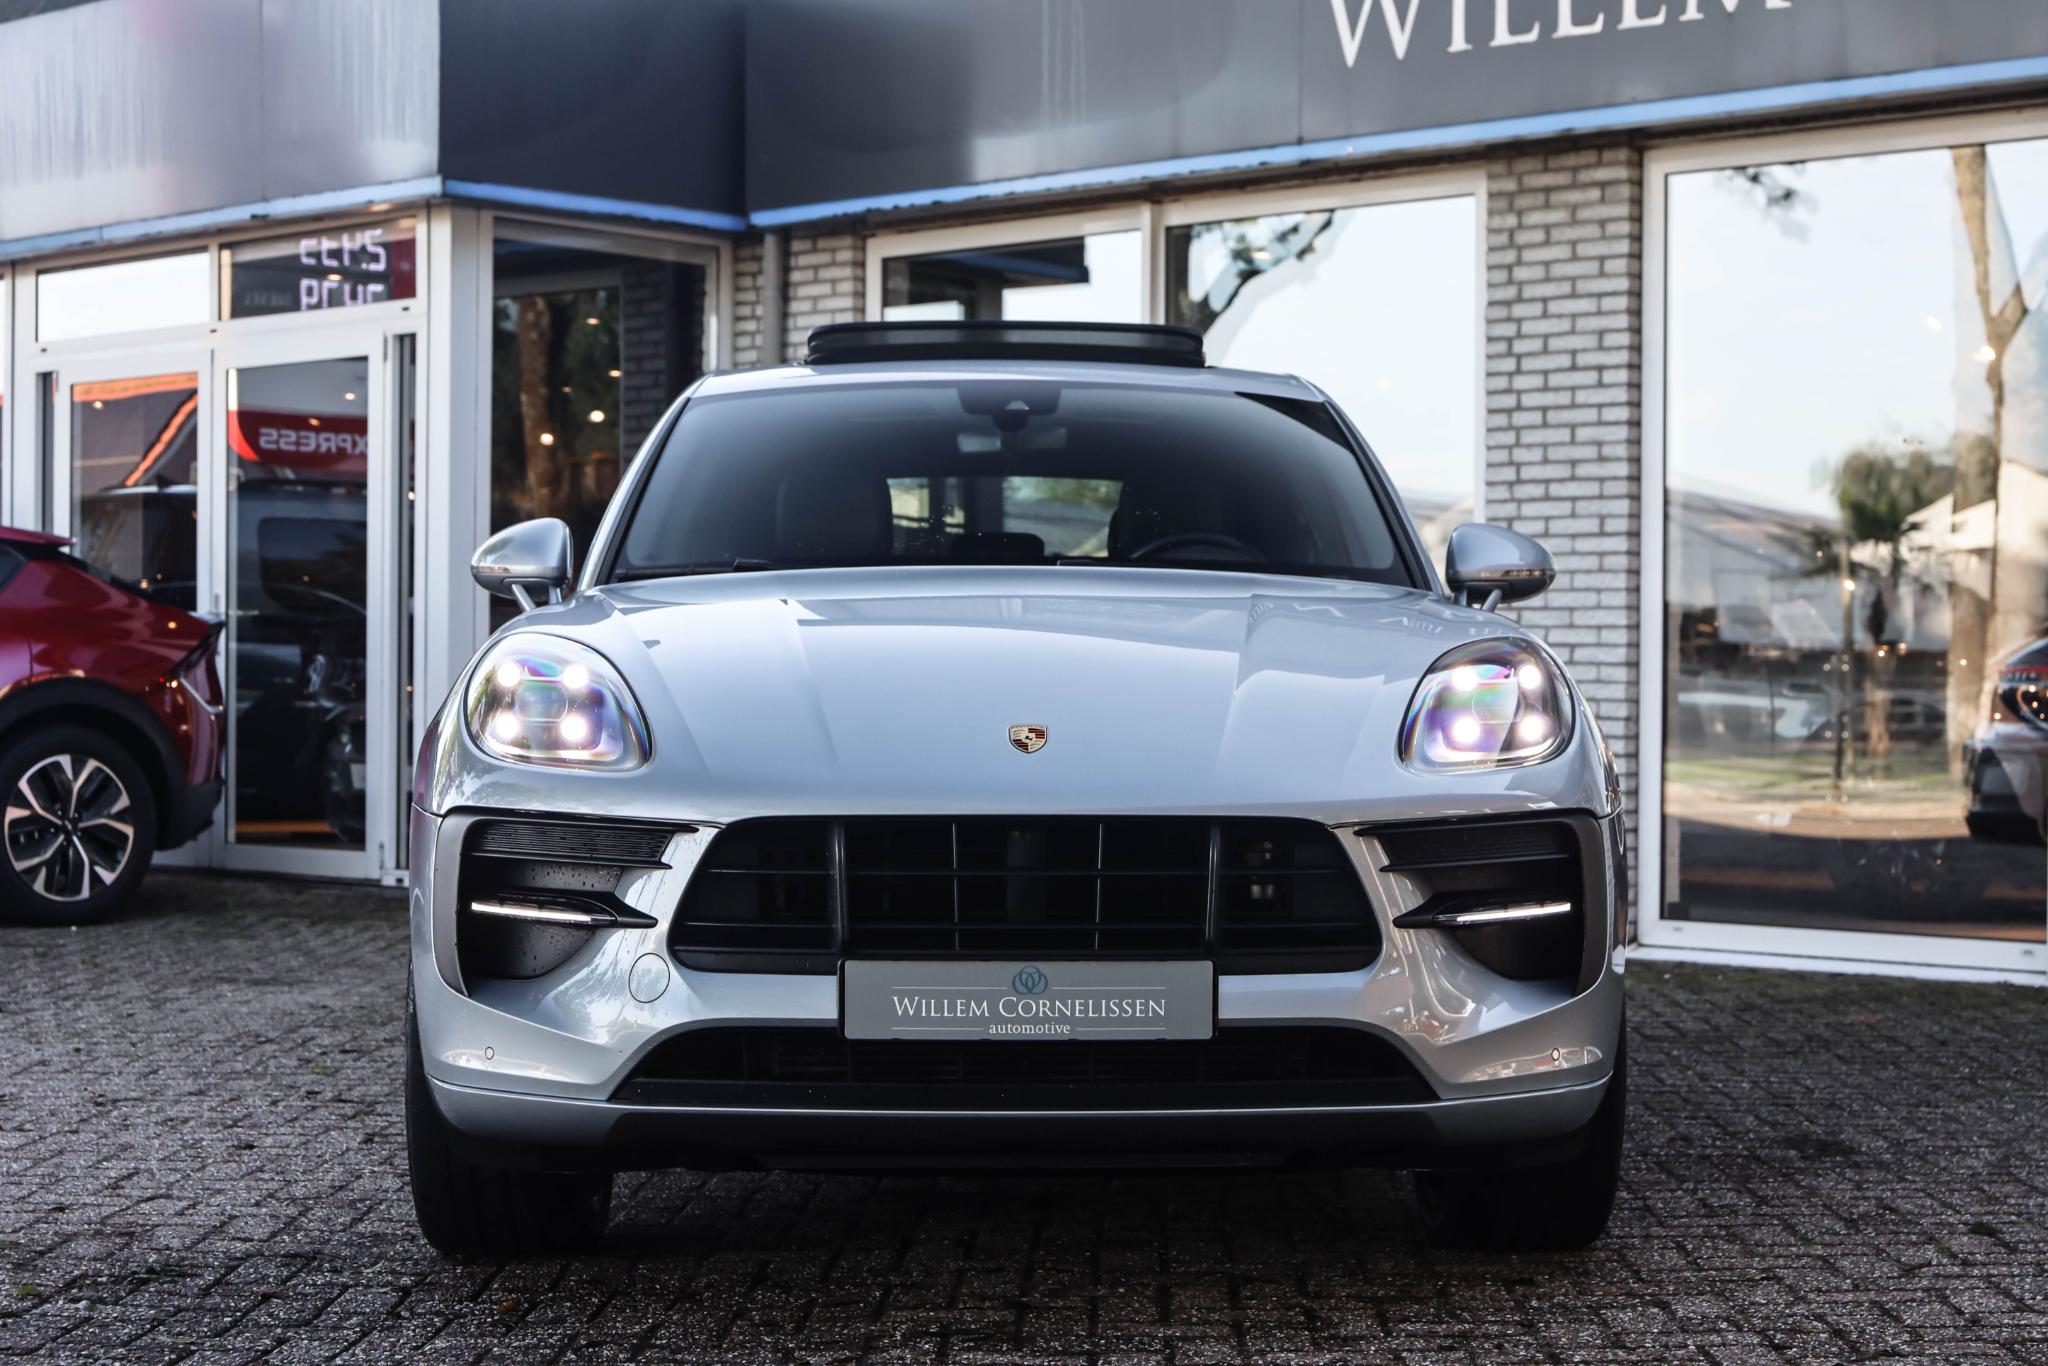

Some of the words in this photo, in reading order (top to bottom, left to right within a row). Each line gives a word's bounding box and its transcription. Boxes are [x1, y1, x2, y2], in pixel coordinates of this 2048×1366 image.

[1330, 0, 1794, 68] WIL
[892, 996, 990, 1017] WILLEM
[998, 996, 1166, 1018] CORNELISSEN
[988, 1021, 1072, 1035] automotive
